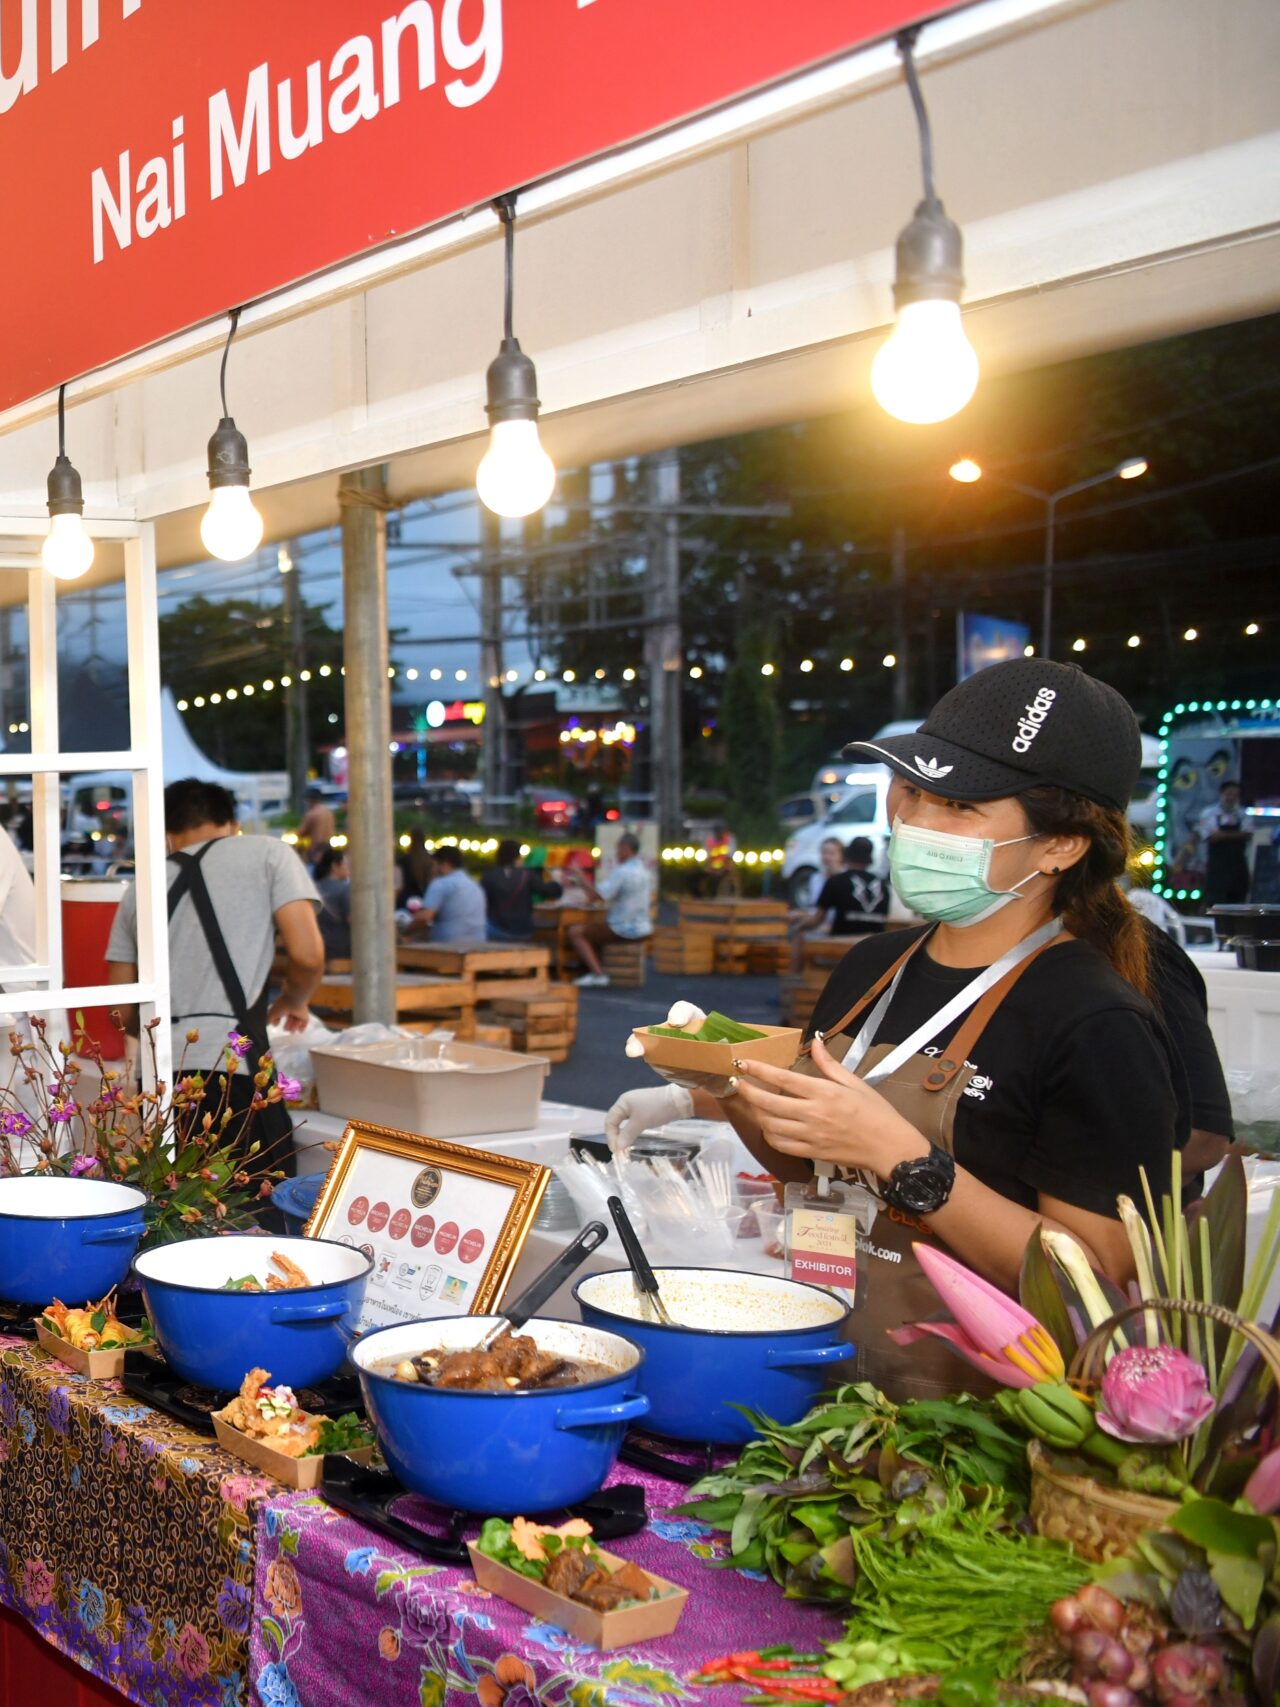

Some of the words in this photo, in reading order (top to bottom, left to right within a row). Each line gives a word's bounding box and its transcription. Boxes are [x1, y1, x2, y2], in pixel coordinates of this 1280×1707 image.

[91, 115, 186, 264] Nai
[208, 0, 504, 200] Muang
[1012, 687, 1056, 753] adidas
[794, 1259, 852, 1277] EXHIBITOR
